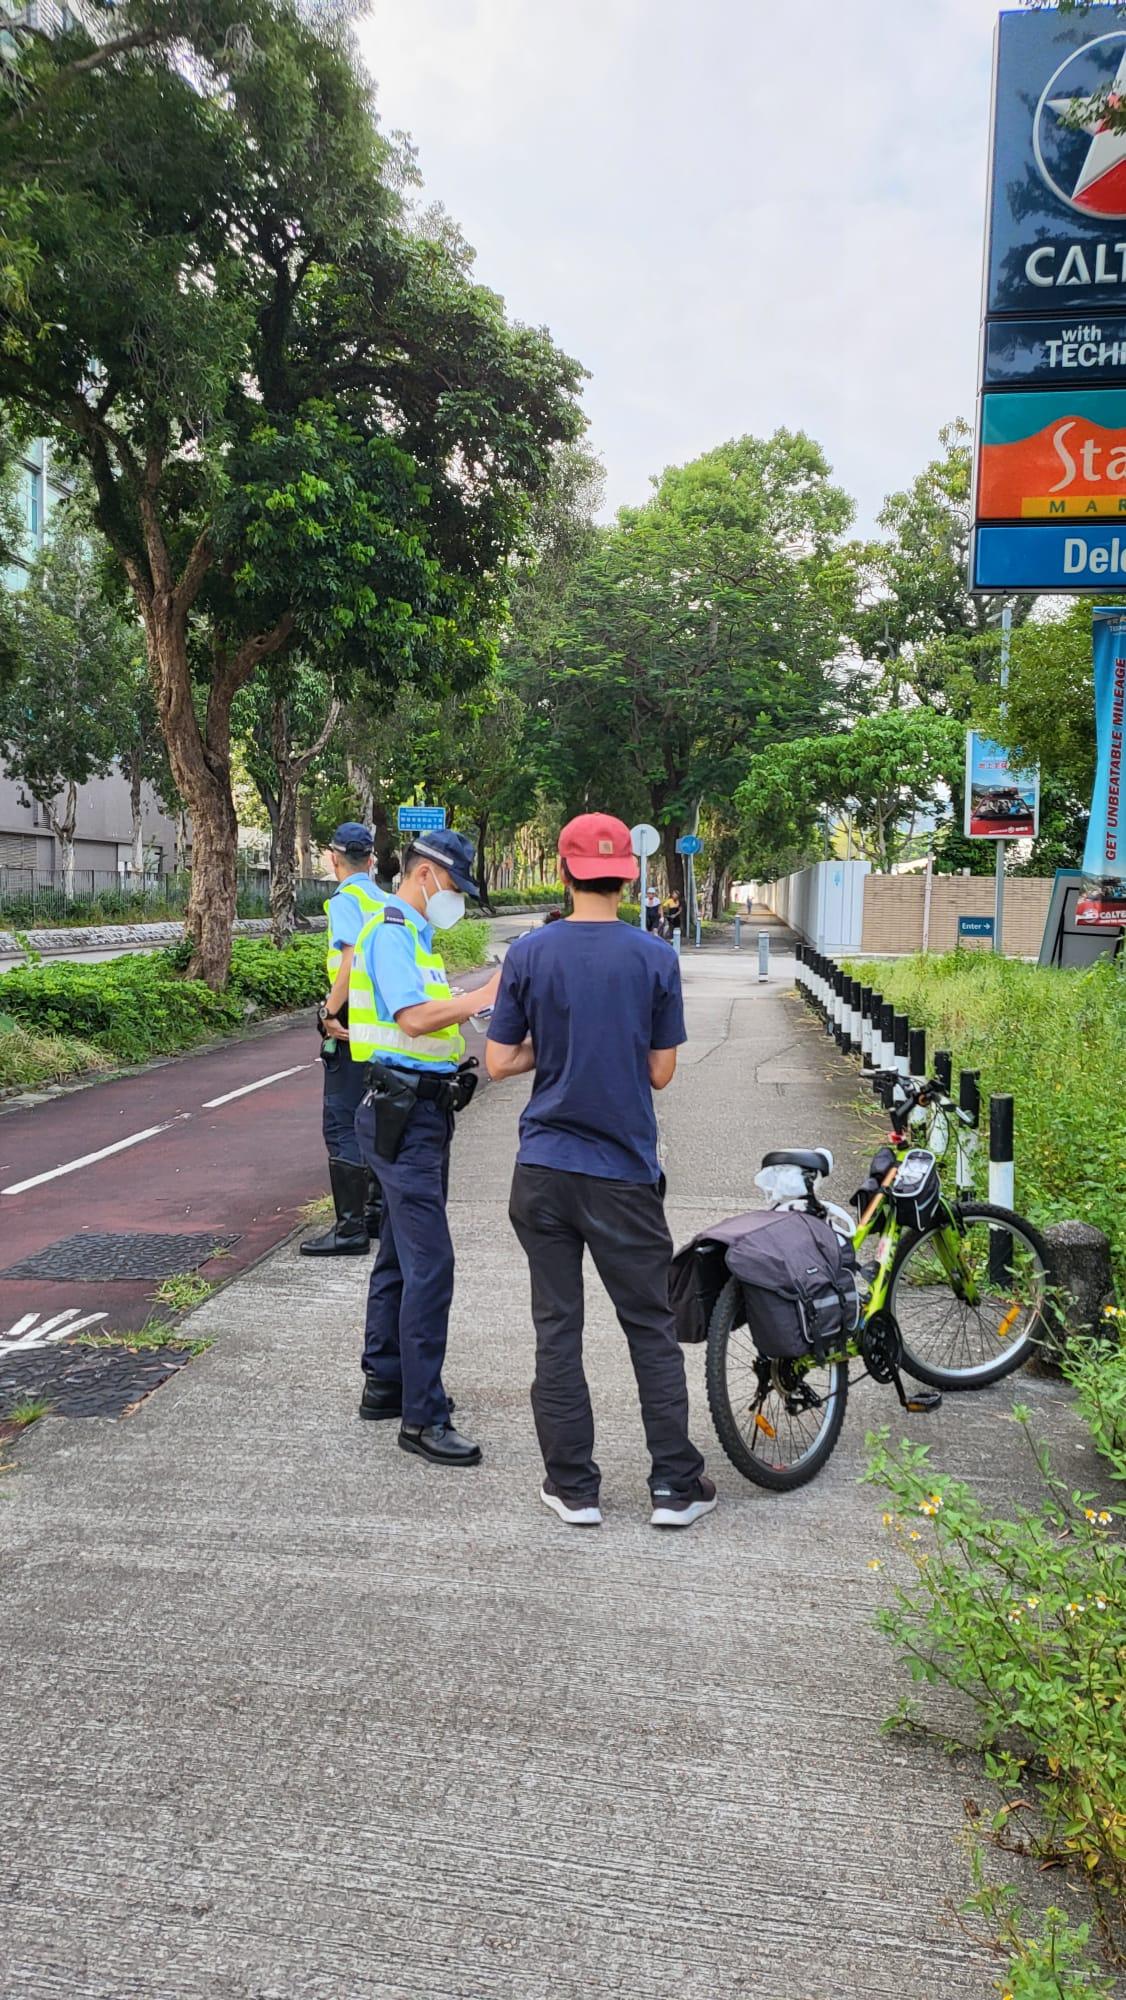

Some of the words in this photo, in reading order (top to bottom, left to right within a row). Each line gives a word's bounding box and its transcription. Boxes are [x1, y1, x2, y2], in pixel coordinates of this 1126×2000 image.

[1062, 325, 1102, 342] with
[1113, 658, 1126, 726] MILEAGE
[1107, 730, 1122, 828] UNBEATABLE
[1105, 832, 1117, 861] GET
[961, 922, 982, 930] Enter
